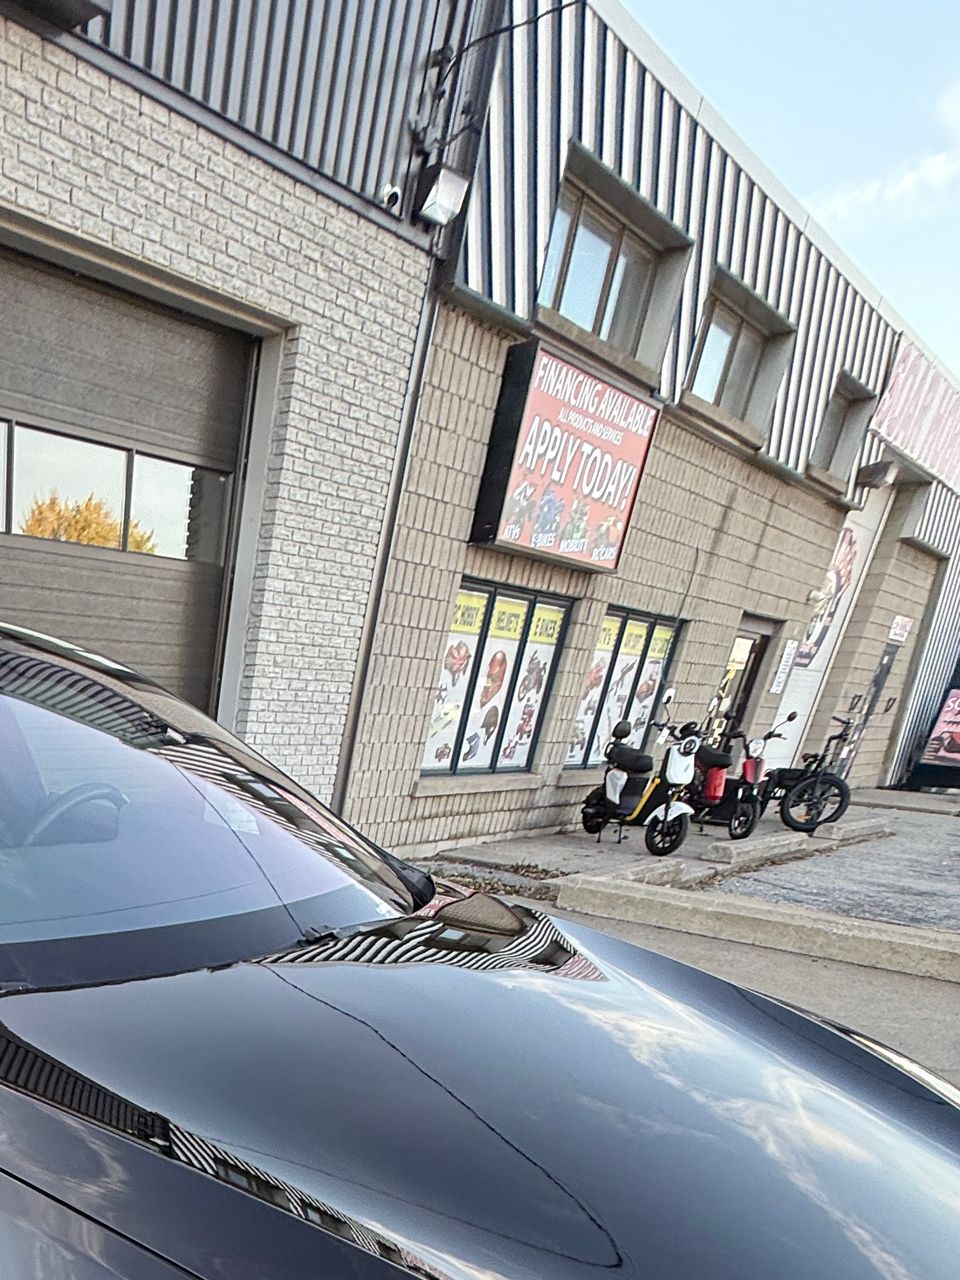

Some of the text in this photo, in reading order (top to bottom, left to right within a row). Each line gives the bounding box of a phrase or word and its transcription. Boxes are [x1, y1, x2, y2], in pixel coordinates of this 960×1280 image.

[533, 356, 656, 437] FINANCING AVAILABLE
[518, 416, 637, 510] APPLY TODAY!
